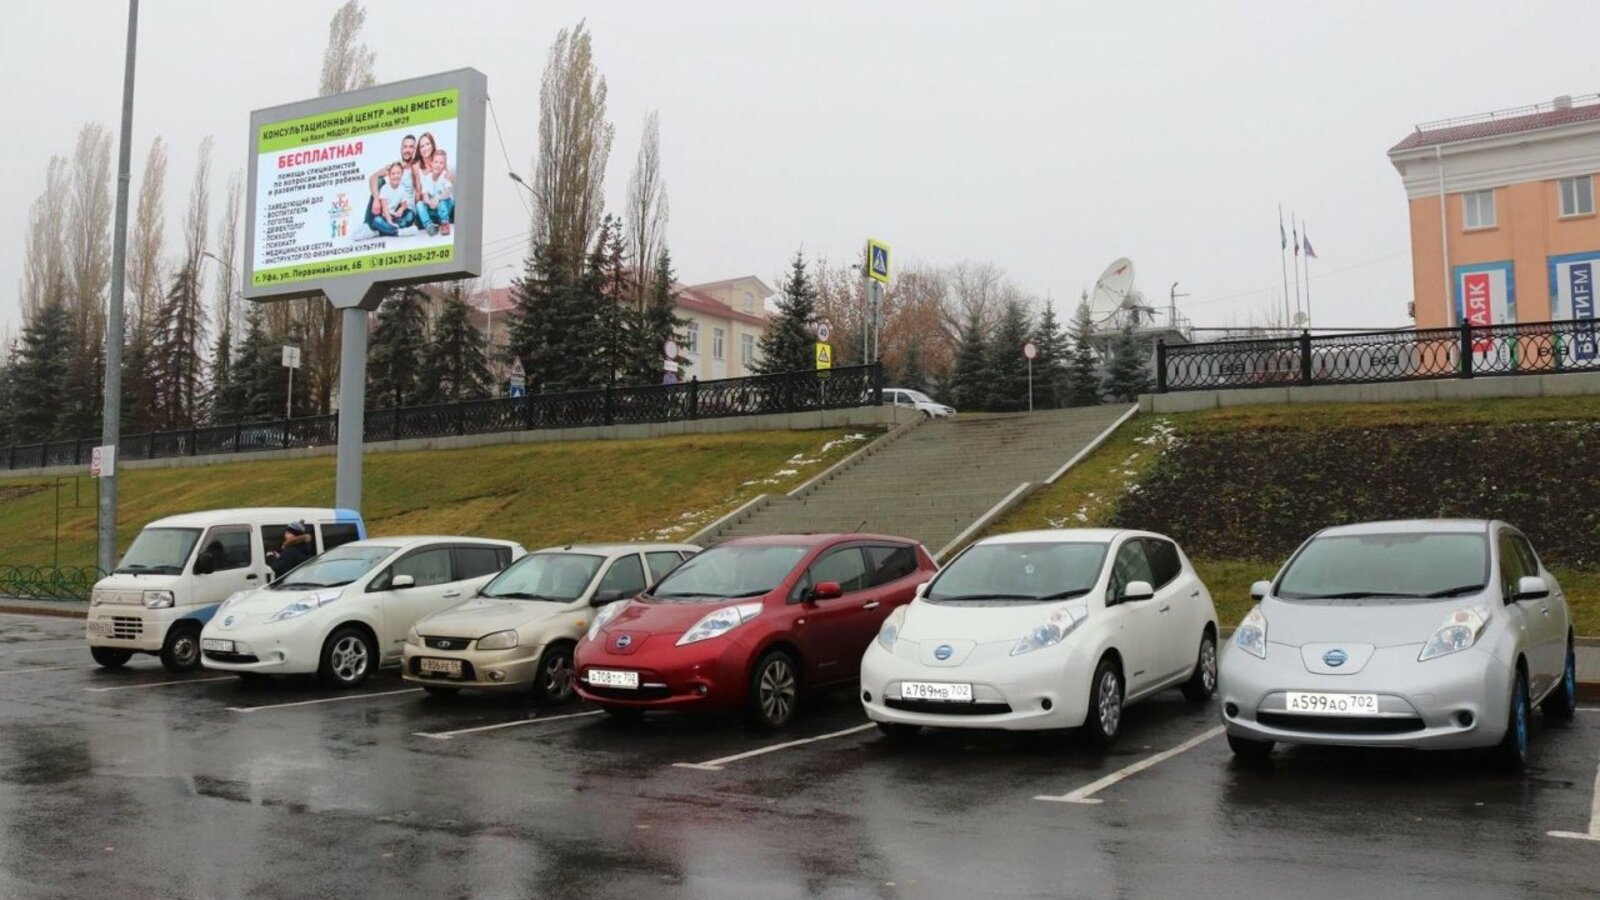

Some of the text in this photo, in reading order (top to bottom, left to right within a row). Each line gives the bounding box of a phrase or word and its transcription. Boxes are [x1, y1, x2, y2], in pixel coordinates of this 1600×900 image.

[263, 113, 354, 140] КОНСУЛЬТАЦИОННЫЙ
[355, 109, 385, 123] ЦЕНТР
[410, 97, 453, 112] ВМЕСТЕ»
[310, 133, 325, 141] базе
[326, 127, 350, 137] МБДОУ
[351, 123, 380, 134] Детский
[381, 120, 393, 128] сад
[394, 116, 410, 125] №29
[278, 141, 364, 169] БЕСПЛАТНАЯ
[278, 161, 356, 179] помощь специалистов
[283, 176, 317, 187] вопросам
[318, 168, 360, 180] воспитания
[274, 185, 306, 196] развития
[307, 179, 333, 189] вашего
[335, 174, 365, 186] ребенка
[267, 206, 308, 218] ВОСПИТАТЕЛЬ
[268, 198, 310, 211] ЗАВЕДУЮЩИЙ
[267, 216, 294, 226] ЛОГОПЕД
[267, 222, 305, 234] ДЕФЕКТОЛОГ
[266, 231, 297, 241] ПСИХОЛОГ
[266, 239, 297, 249] ПСИХИАТР
[265, 242, 386, 264] ИНСТРУКТОР ПО ФИЗИЧЕСКОЙ КУЛЬТУРЕ
[266, 241, 333, 256] МЕДИЦИНСКАЯ СЕСТРА
[293, 264, 350, 278] Первомайская,
[378, 258, 384, 266] 8
[385, 254, 406, 266] (347)
[407, 249, 450, 263] 240-27-00
[1470, 281, 1491, 346] АЯК
[906, 684, 969, 698] А789МВ 702
[1292, 695, 1374, 711] А599АО 702
